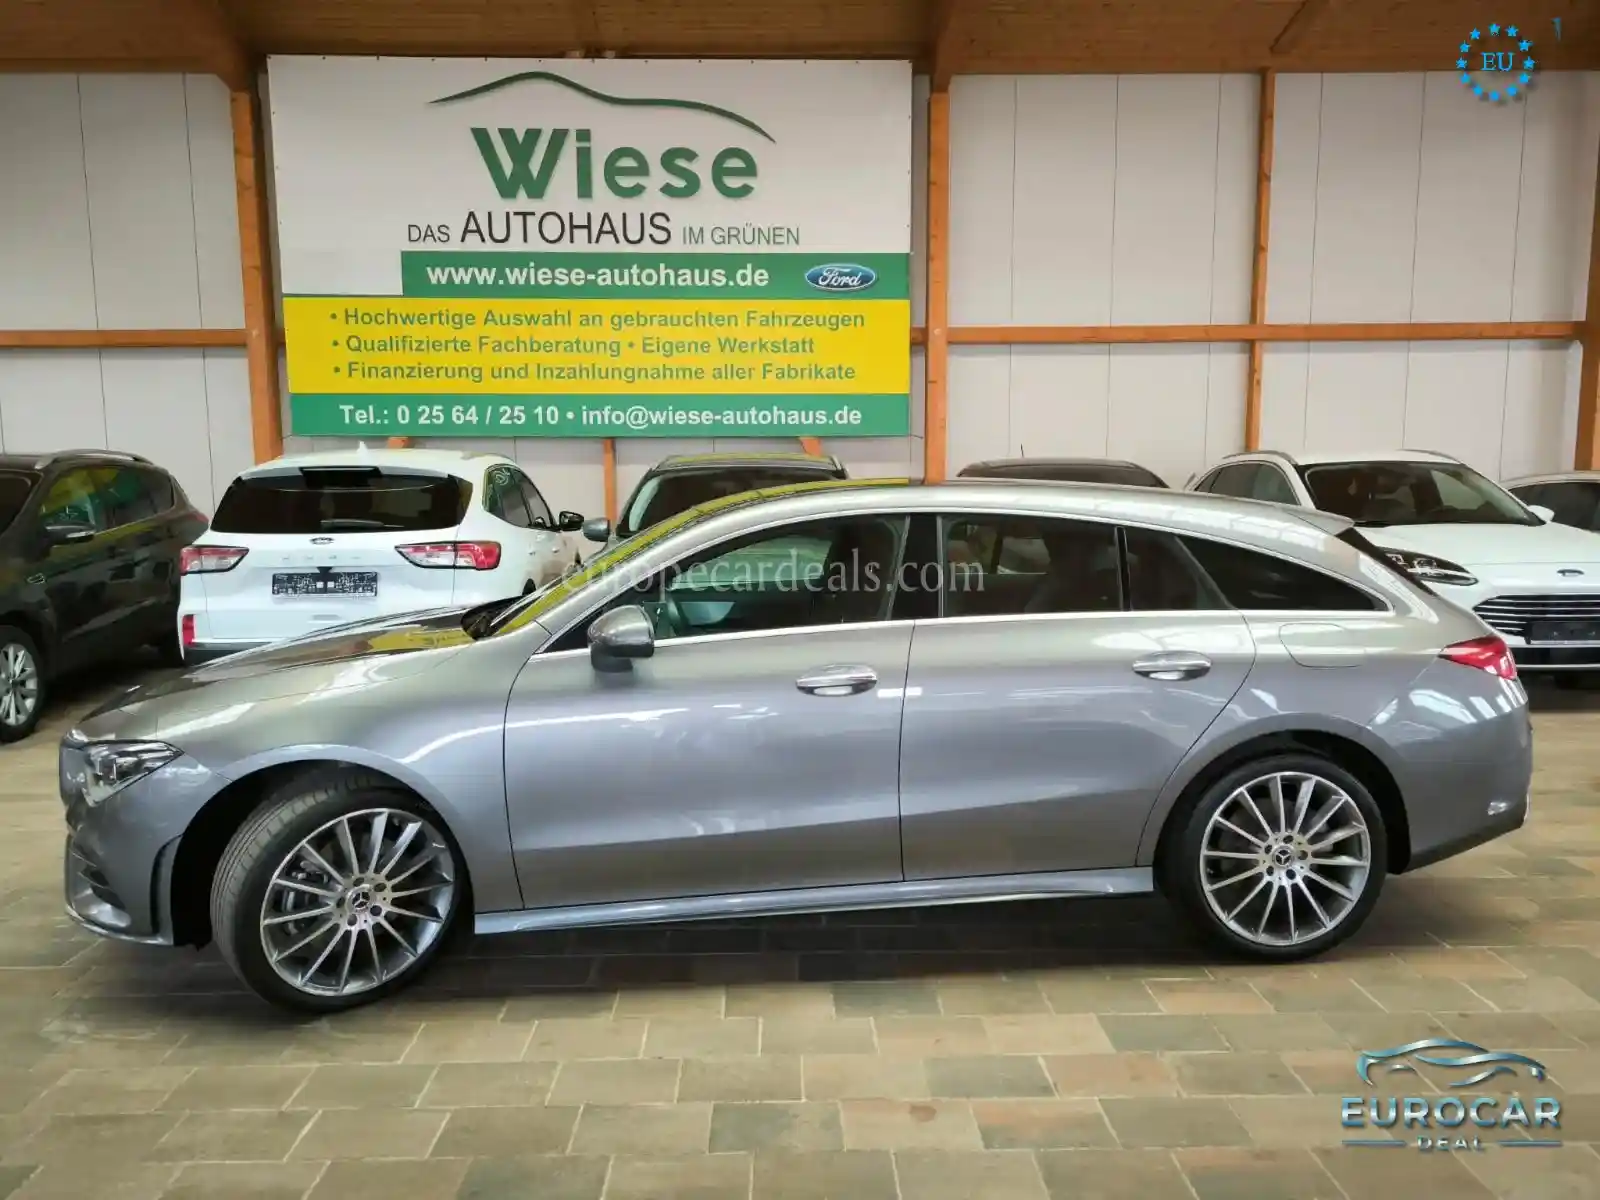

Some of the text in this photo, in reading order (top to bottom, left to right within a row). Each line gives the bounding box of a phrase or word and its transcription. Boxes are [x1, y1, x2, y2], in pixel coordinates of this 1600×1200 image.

[470, 127, 758, 199] Wiese
[407, 211, 800, 245] DAS AUTOHAUS IM GRÜNEN
[426, 262, 769, 287] www.wiese-autohaus.de
[818, 267, 862, 286] Ford
[344, 308, 865, 331] Hochwertige Auswahl an gebrauchten Fahrzeugen
[346, 335, 815, 357] Qualifizierte Fachberatung Eigene Werkstatt
[347, 362, 855, 383] Finanzierung und Inzahlungnahme aller Fabrikate
[339, 405, 389, 425] Tel.:
[397, 406, 410, 425] 0
[417, 406, 444, 425] 25
[451, 406, 479, 425] 64
[499, 406, 525, 425] 25
[533, 406, 559, 425] 10
[581, 405, 862, 430] info@wiese-autohaus.de
